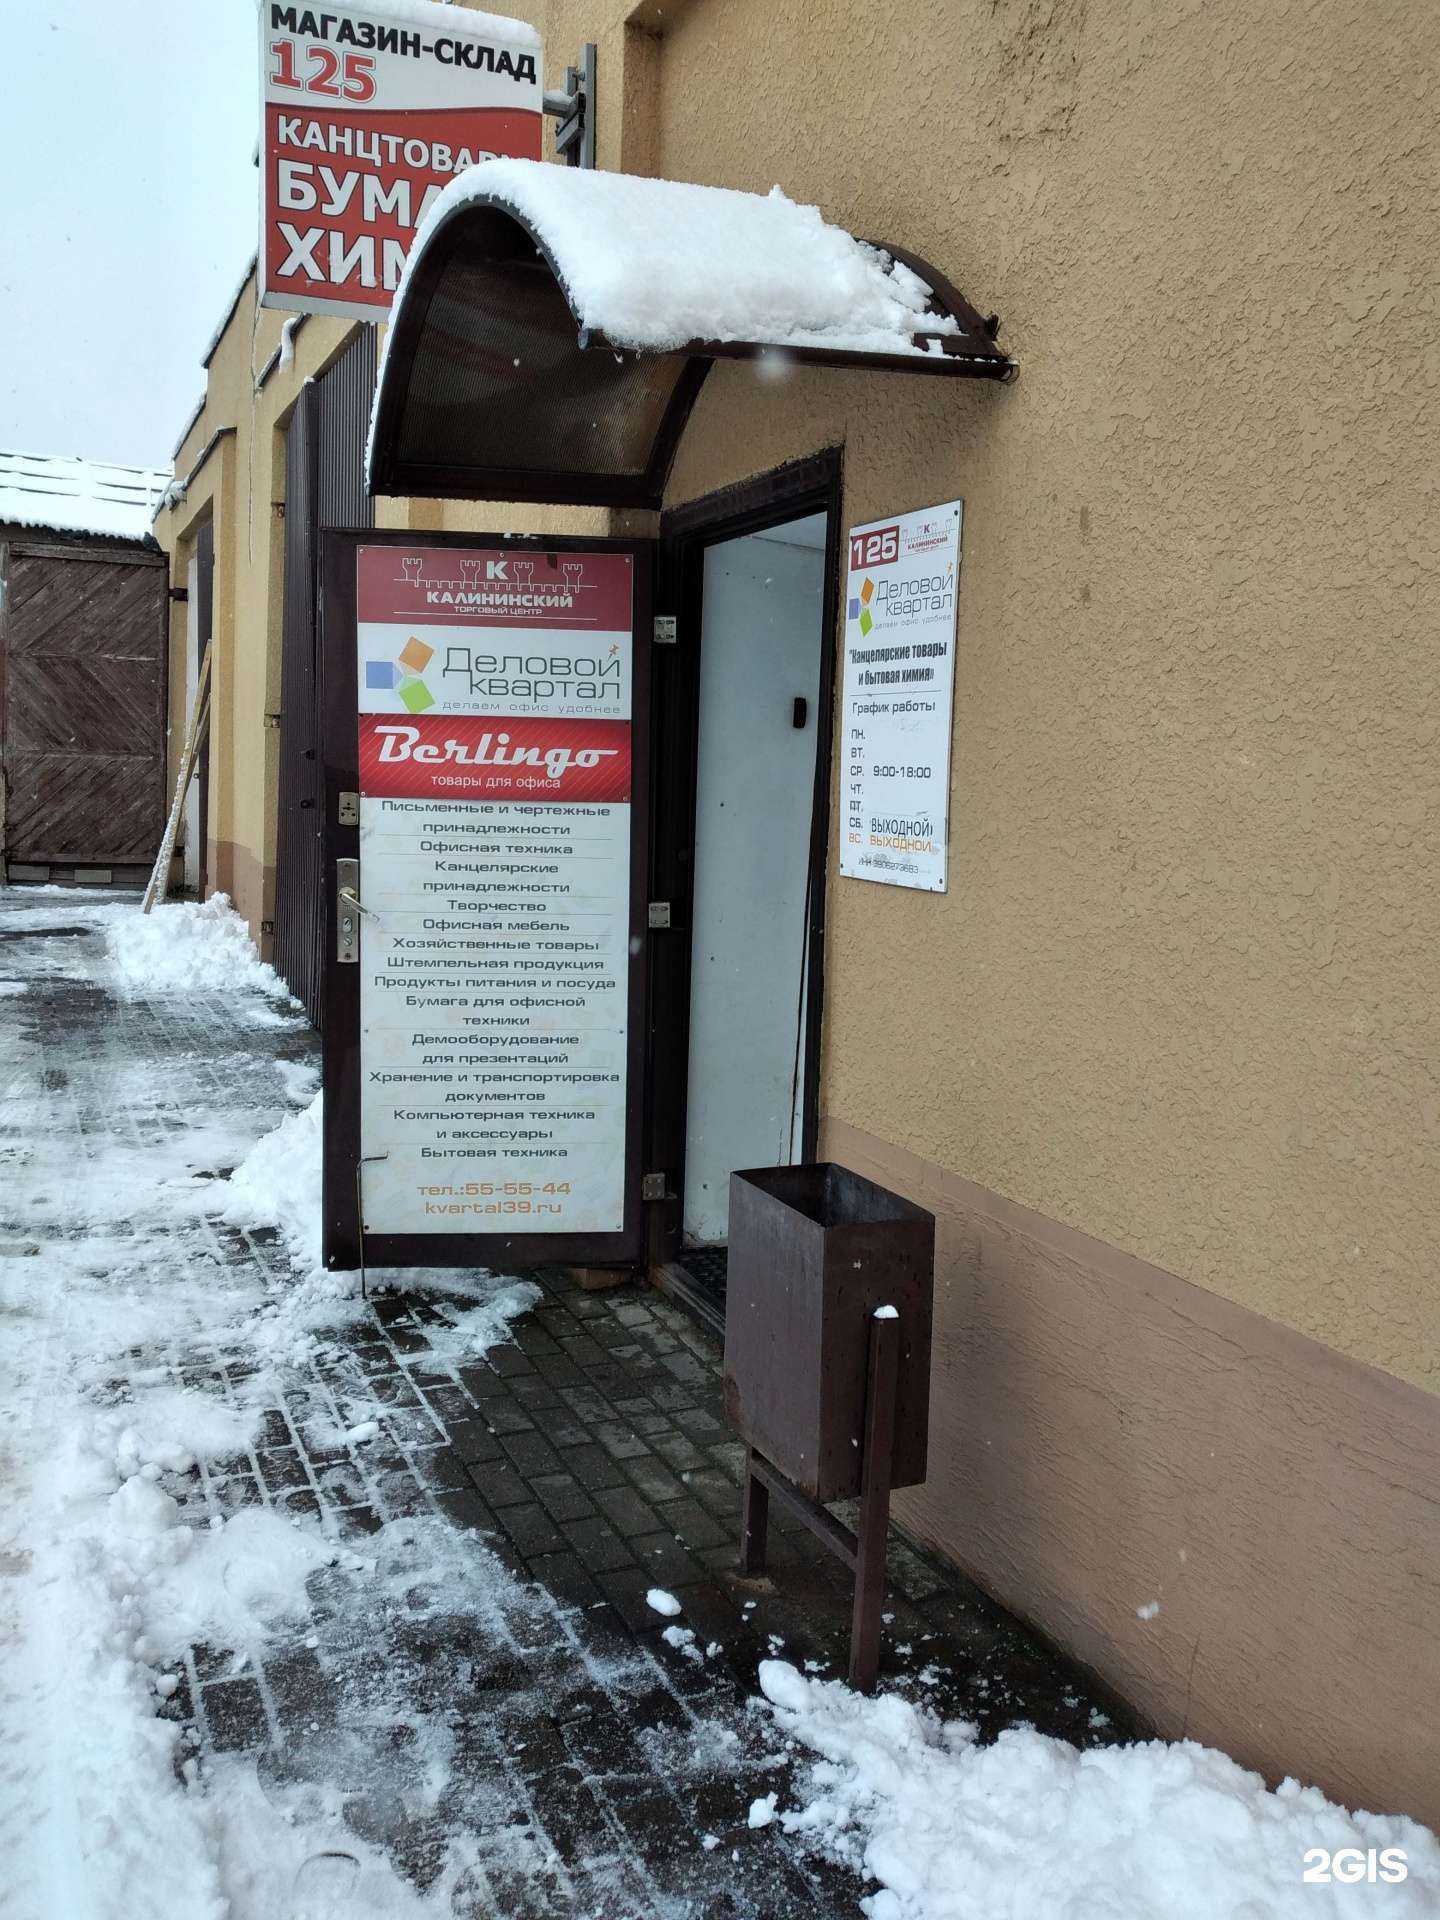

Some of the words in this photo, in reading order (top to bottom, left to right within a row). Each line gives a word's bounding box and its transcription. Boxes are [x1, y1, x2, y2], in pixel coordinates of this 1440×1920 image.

[271, 4, 536, 85] МАГАЗИН-СКЛАД
[270, 39, 376, 102] 125
[853, 532, 897, 566] 125
[486, 560, 508, 580] К
[876, 573, 953, 605] Деловой
[427, 591, 573, 608] КАЛИНИНСКИЙ
[886, 593, 952, 618] квартал
[453, 605, 508, 615] ТОРГОВЫЙ
[510, 607, 543, 616] ЦЕНТР
[912, 642, 947, 657] товары
[443, 646, 621, 678] Деловой
[858, 673, 864, 686] и
[865, 670, 900, 685] бытовая
[470, 671, 621, 703] квартал
[443, 701, 500, 711] делаем
[509, 702, 549, 713] офис
[559, 704, 621, 715] удобнее
[852, 702, 889, 716] График
[892, 701, 936, 714] работы
[851, 729, 866, 740] ПН.
[374, 725, 618, 779] Berlingo
[851, 747, 865, 758] ВТ.
[850, 766, 864, 777] СР.
[873, 765, 931, 779] 9:00-18:00
[431, 776, 482, 788] товары
[486, 777, 512, 788] для
[516, 775, 560, 789] офиса
[850, 784, 864, 795] ЧТ.
[381, 801, 494, 814] Письменные
[499, 805, 509, 814] и
[514, 806, 611, 817] чертежные
[423, 822, 571, 835] принадлежности
[849, 818, 863, 829] СБ.
[848, 833, 863, 844] ВС.
[420, 841, 501, 854] Офисная
[505, 844, 573, 855] техника
[434, 860, 559, 874] Канцелярские
[423, 881, 570, 894] принадлежности
[447, 900, 547, 912] Творчество
[423, 919, 503, 931] Офисная
[507, 921, 570, 931] мебель
[392, 938, 531, 950] Хозяйственные
[536, 940, 600, 952] товары
[387, 957, 509, 969] Штемпельная
[513, 959, 604, 972] продукция
[374, 976, 461, 989] Продукты
[465, 978, 537, 988] питания
[541, 979, 552, 988] и
[556, 979, 616, 990] посуда
[406, 996, 468, 1008] Бумага
[473, 997, 504, 1008] для
[509, 995, 586, 1009] офисной
[462, 1015, 530, 1026] техники
[412, 1034, 580, 1047] Демооборудование
[422, 1054, 454, 1064] для
[458, 1053, 569, 1066] презентаций
[369, 1071, 453, 1084] Хранение
[458, 1073, 468, 1082] и
[473, 1072, 620, 1085] транспортировка
[445, 1091, 546, 1104] документов
[393, 1109, 525, 1122] Компьютерная
[529, 1111, 595, 1121] техника
[436, 1130, 447, 1139] и
[452, 1129, 553, 1141] аксессуары
[421, 1147, 497, 1158] Бытовая
[502, 1148, 568, 1158] техника
[417, 1182, 571, 1196] тел.:55-55-44
[425, 1201, 562, 1214] kvartal39.ru
